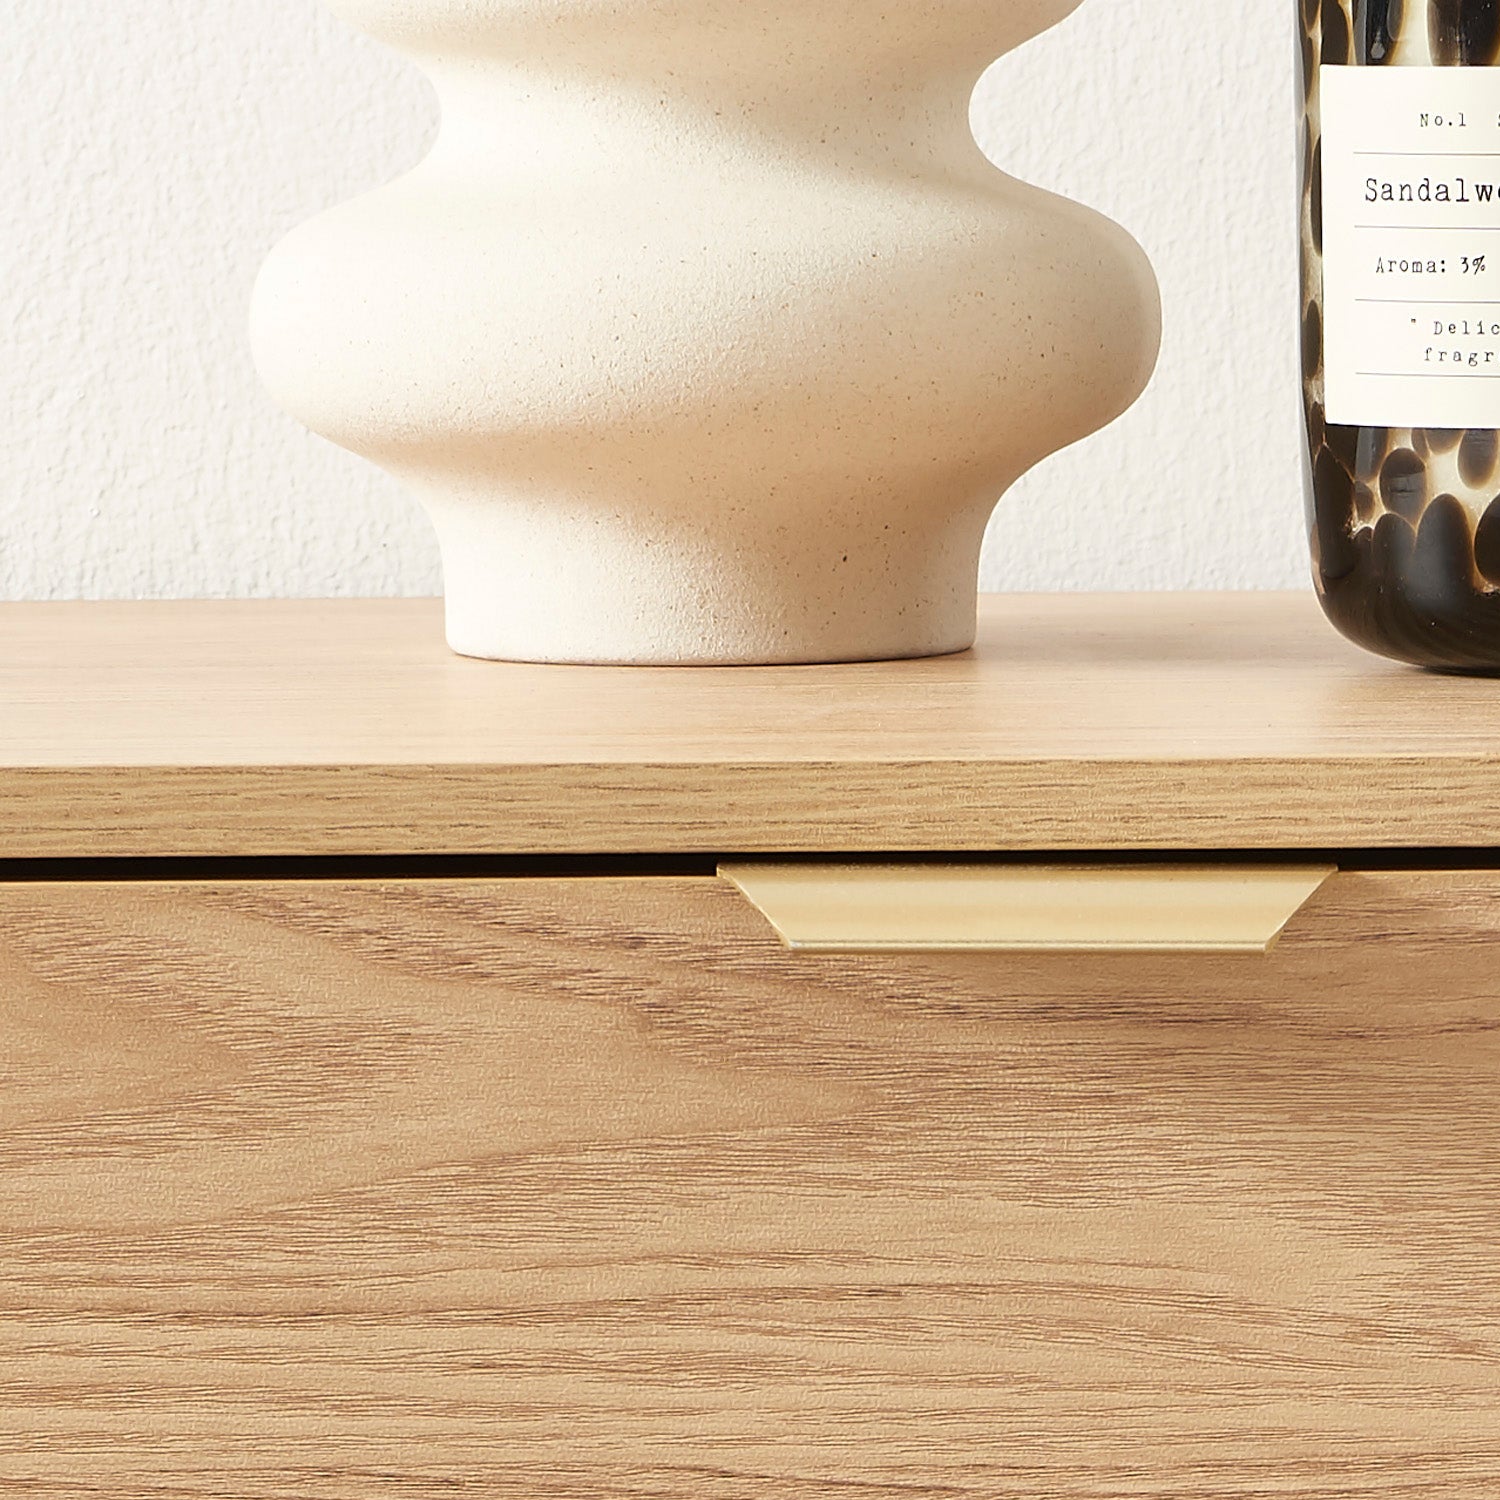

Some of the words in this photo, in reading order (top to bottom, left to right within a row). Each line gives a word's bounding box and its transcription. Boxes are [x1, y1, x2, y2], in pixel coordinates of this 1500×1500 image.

[1420, 112, 1466, 128] No.1
[1375, 257, 1446, 274] Aroma:
[1461, 255, 1486, 275] 3%
